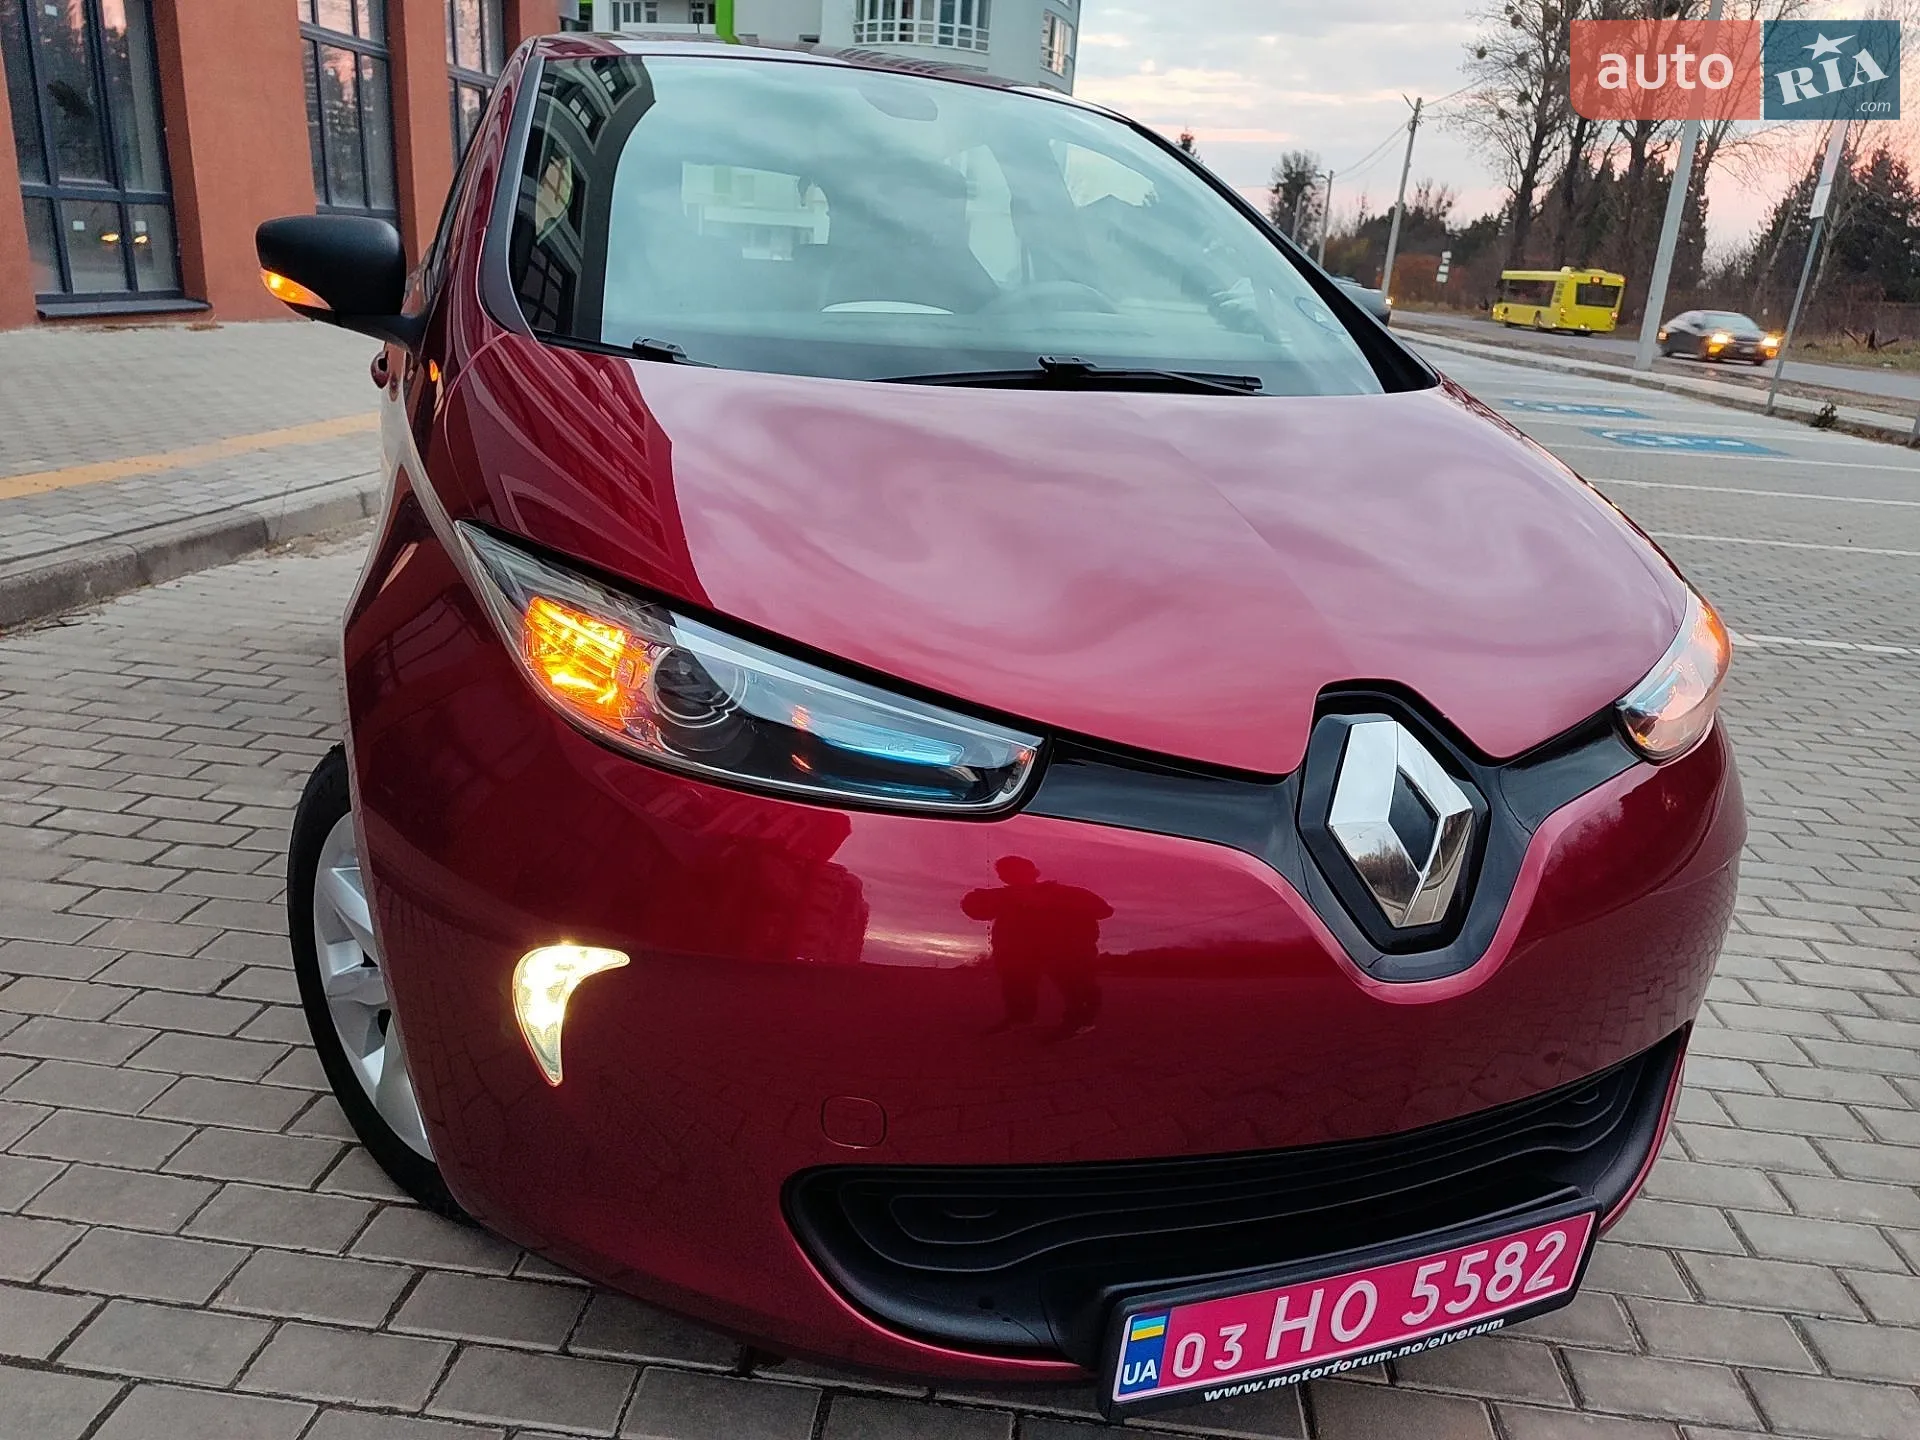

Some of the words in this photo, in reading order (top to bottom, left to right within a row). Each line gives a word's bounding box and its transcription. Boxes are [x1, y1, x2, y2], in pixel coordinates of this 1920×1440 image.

[1172, 1322, 1248, 1379] 03
[1264, 1279, 1377, 1361] HO
[1401, 1229, 1568, 1327] 5582
[1122, 1358, 1158, 1386] UA
[1204, 1317, 1505, 1403] www.motorforum.no/elverum
